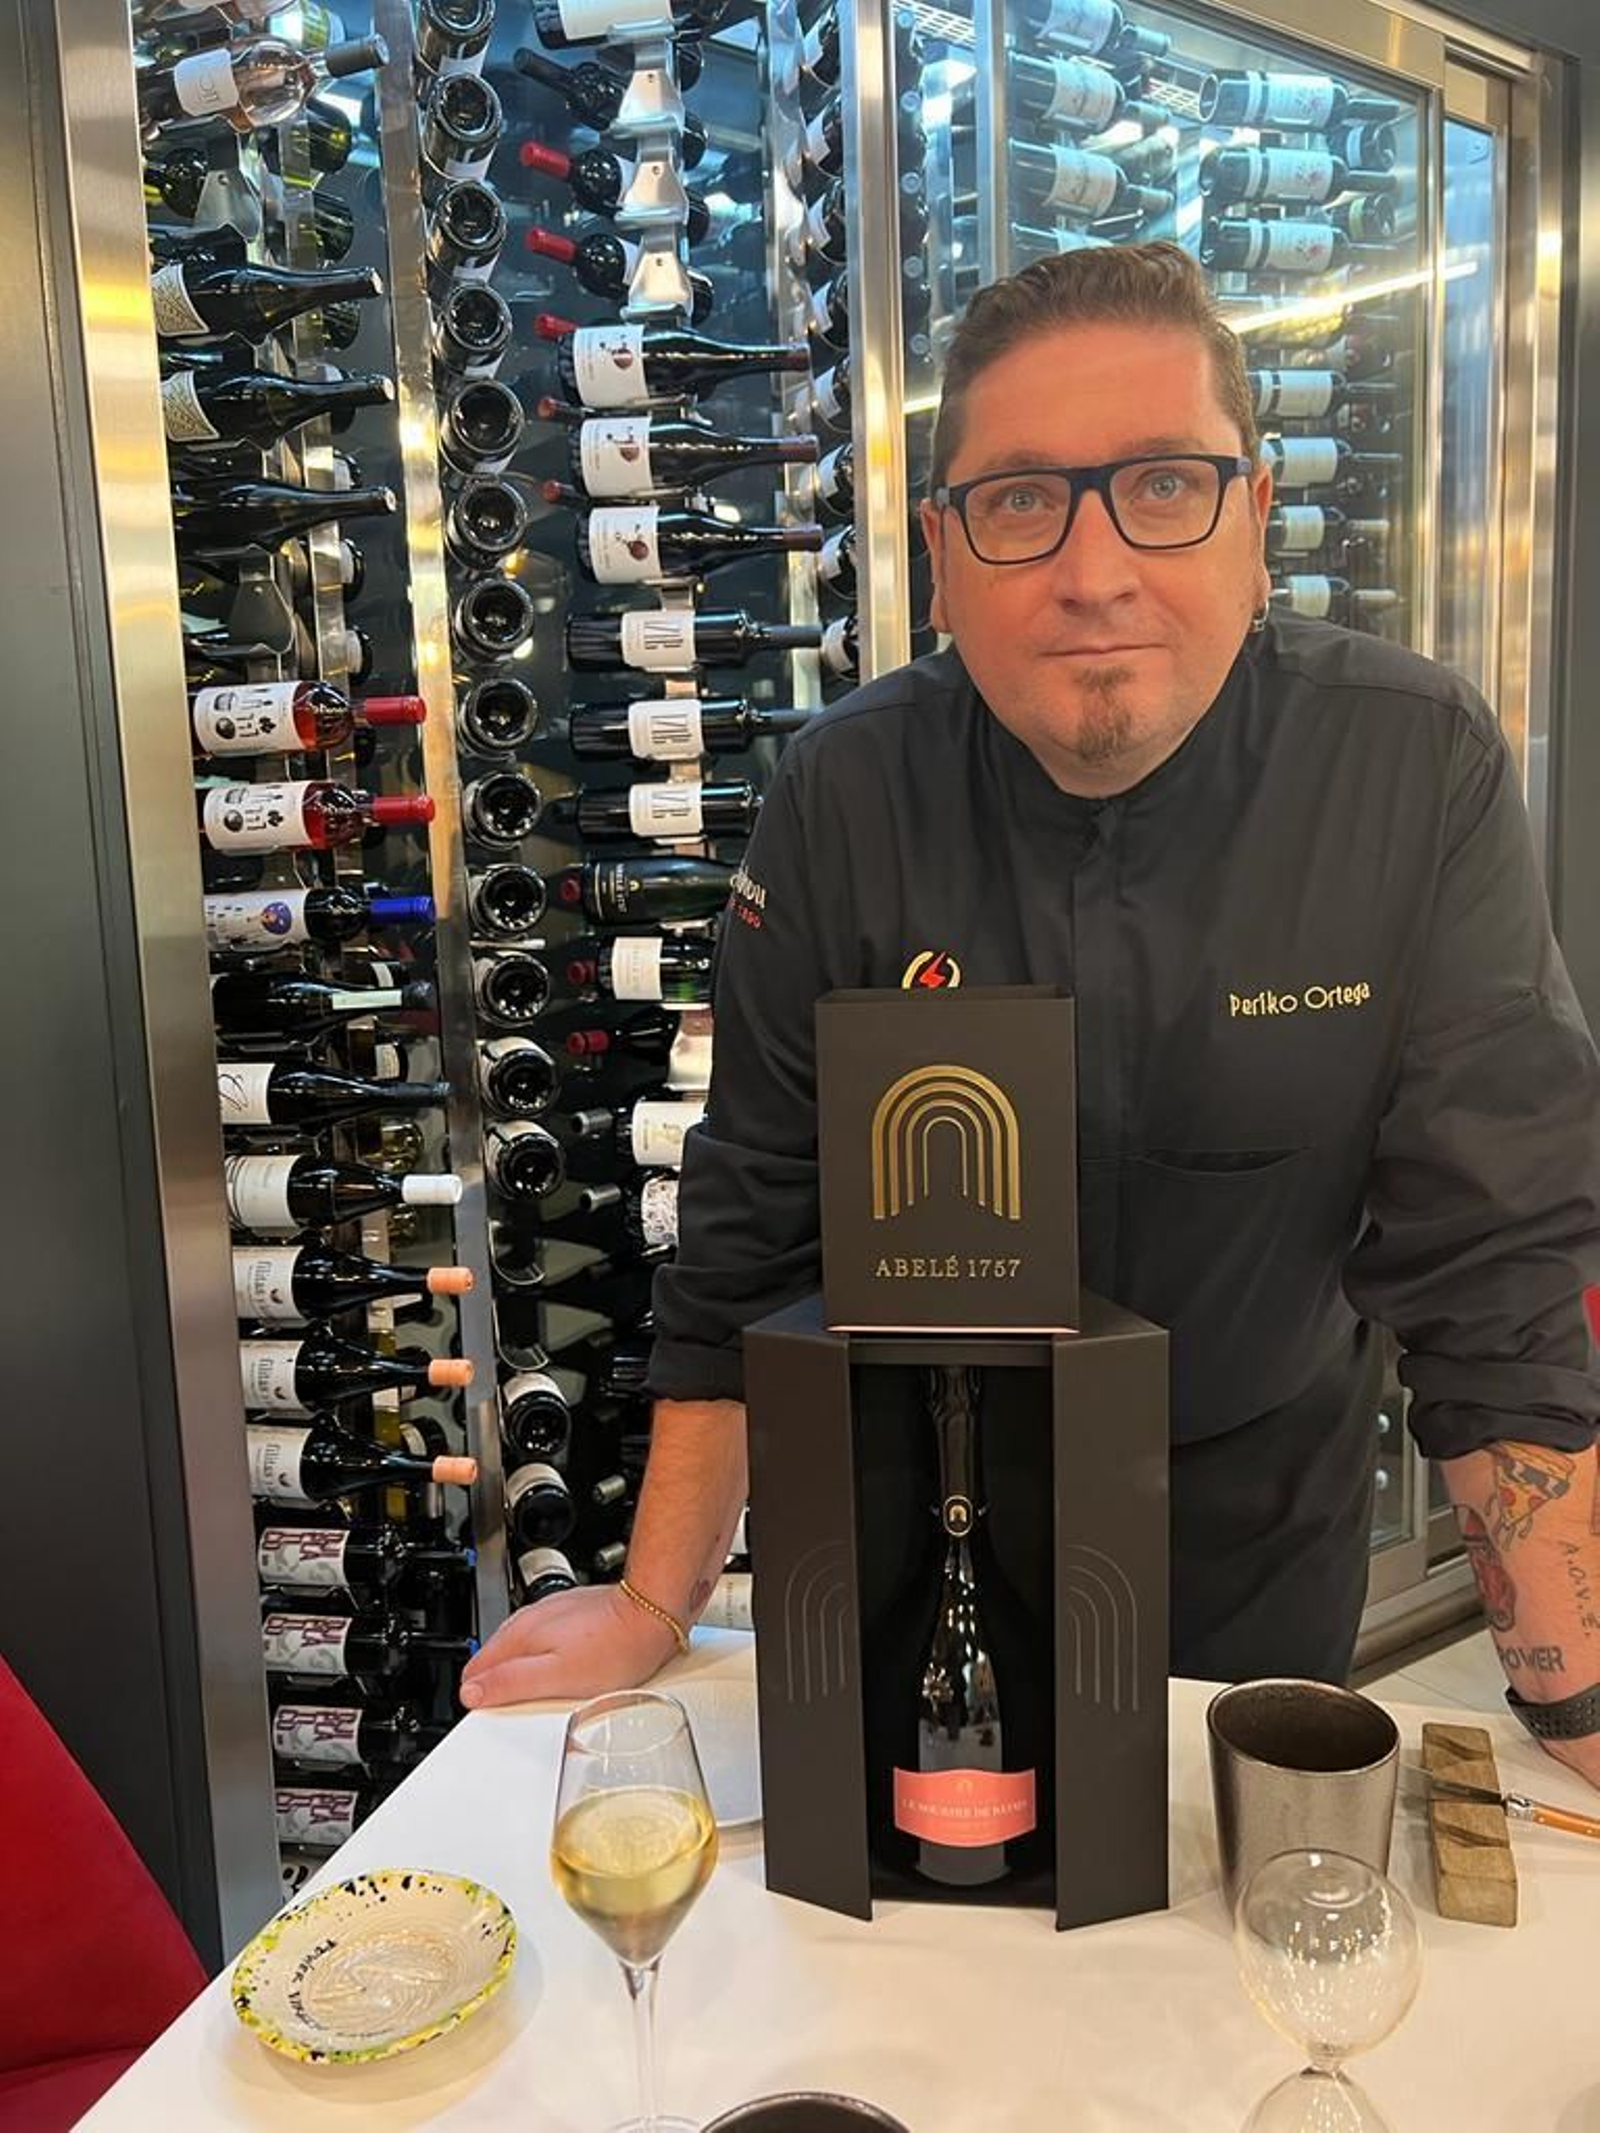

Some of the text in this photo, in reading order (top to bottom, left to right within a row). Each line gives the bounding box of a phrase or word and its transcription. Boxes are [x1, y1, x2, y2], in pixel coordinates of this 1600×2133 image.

[1229, 982, 1371, 1017] Periko Ortega
[875, 1255, 1021, 1278] ABELÉ 1757
